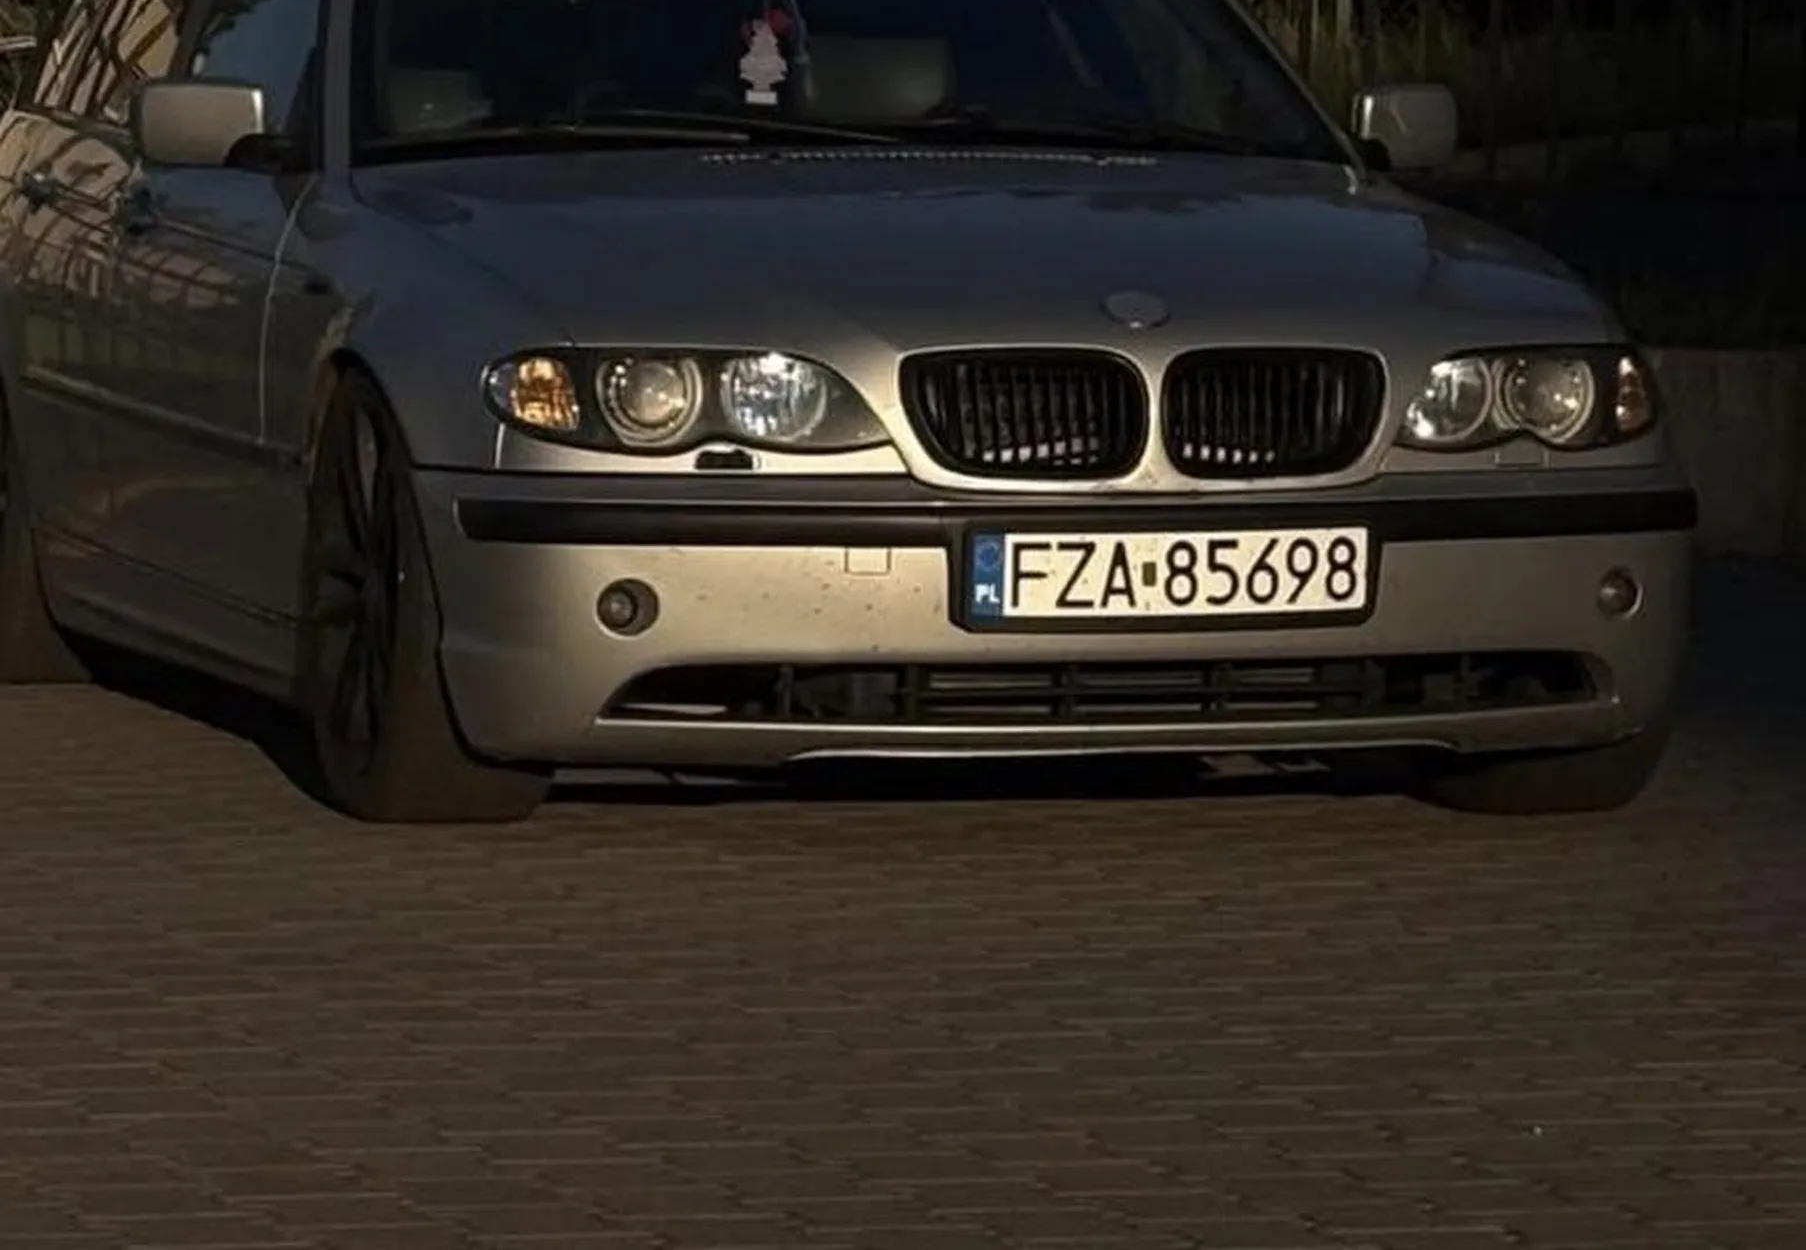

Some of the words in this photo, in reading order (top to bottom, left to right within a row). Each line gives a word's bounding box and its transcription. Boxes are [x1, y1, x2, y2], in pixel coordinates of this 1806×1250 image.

[975, 584, 999, 602] PL
[1011, 541, 1137, 608] FZA
[1164, 536, 1357, 607] 85698
